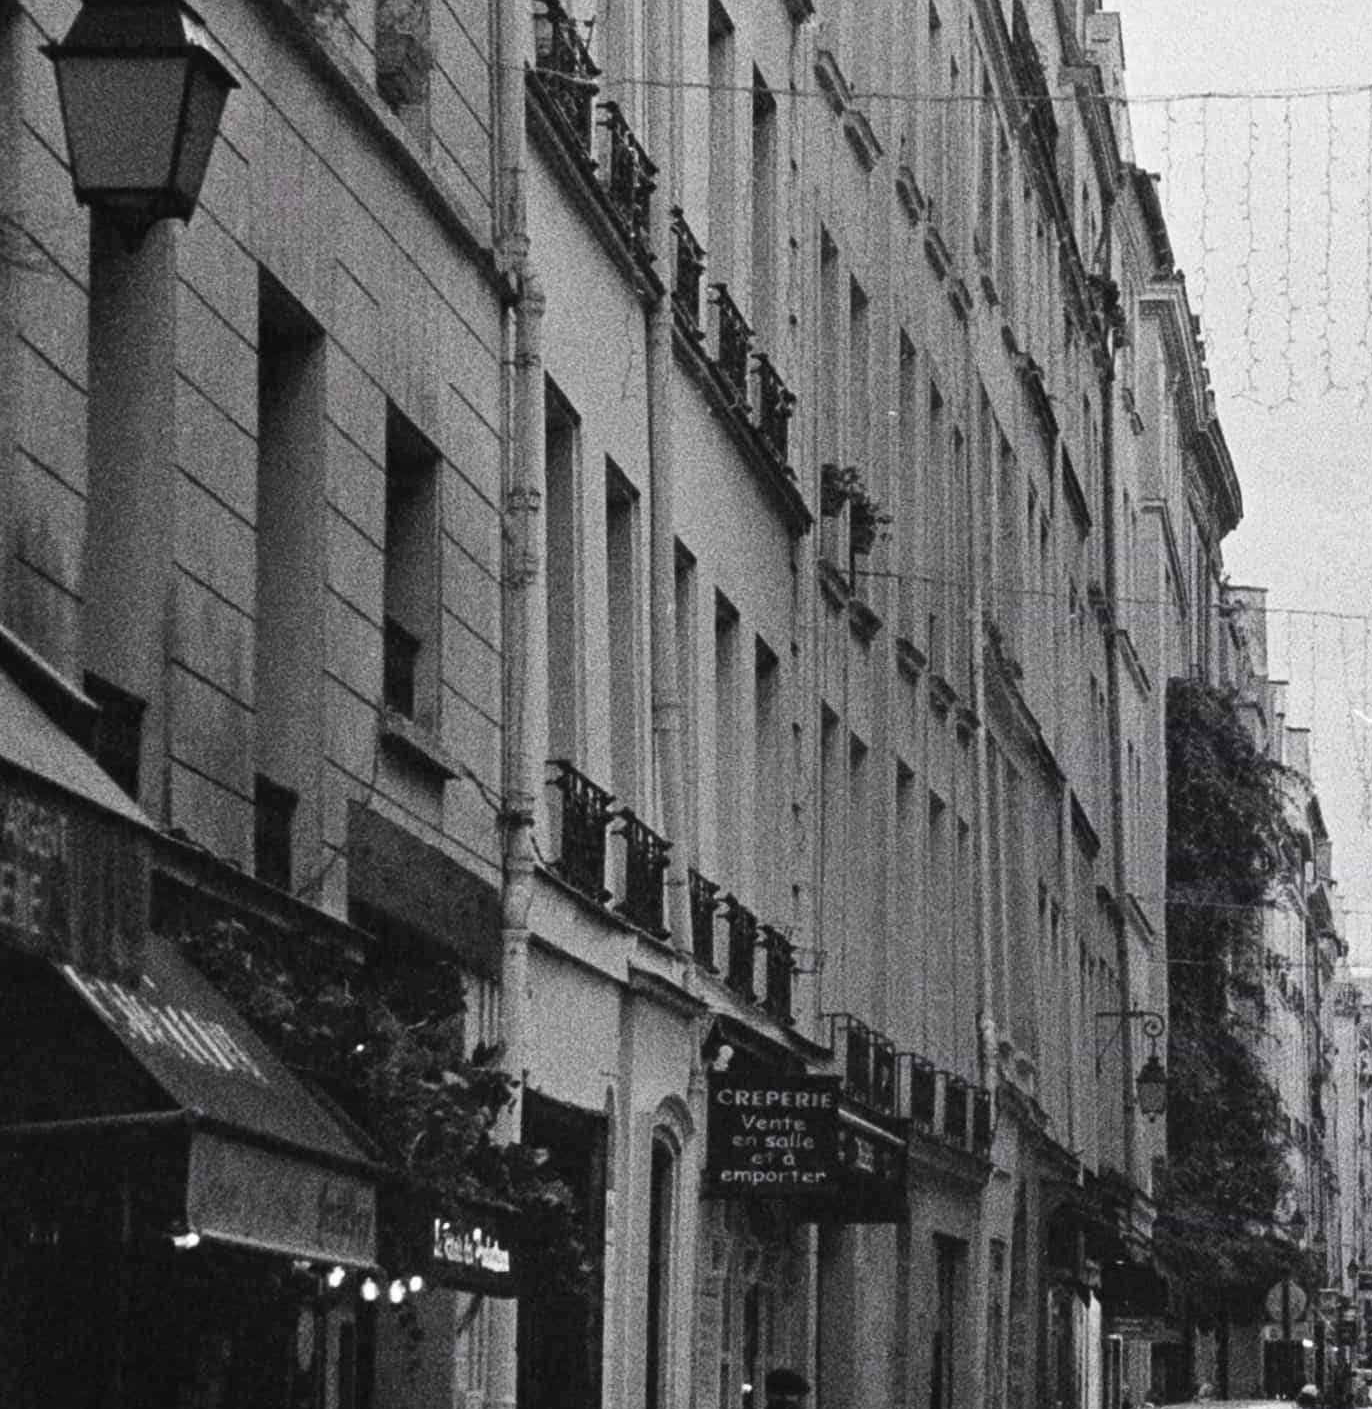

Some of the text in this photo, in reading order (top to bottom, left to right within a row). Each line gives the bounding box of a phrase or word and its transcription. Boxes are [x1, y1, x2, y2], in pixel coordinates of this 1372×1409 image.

[741, 1114, 807, 1131] Vente
[732, 1132, 816, 1150] en salle
[751, 1152, 773, 1165] et
[720, 1169, 827, 1186] emporter
